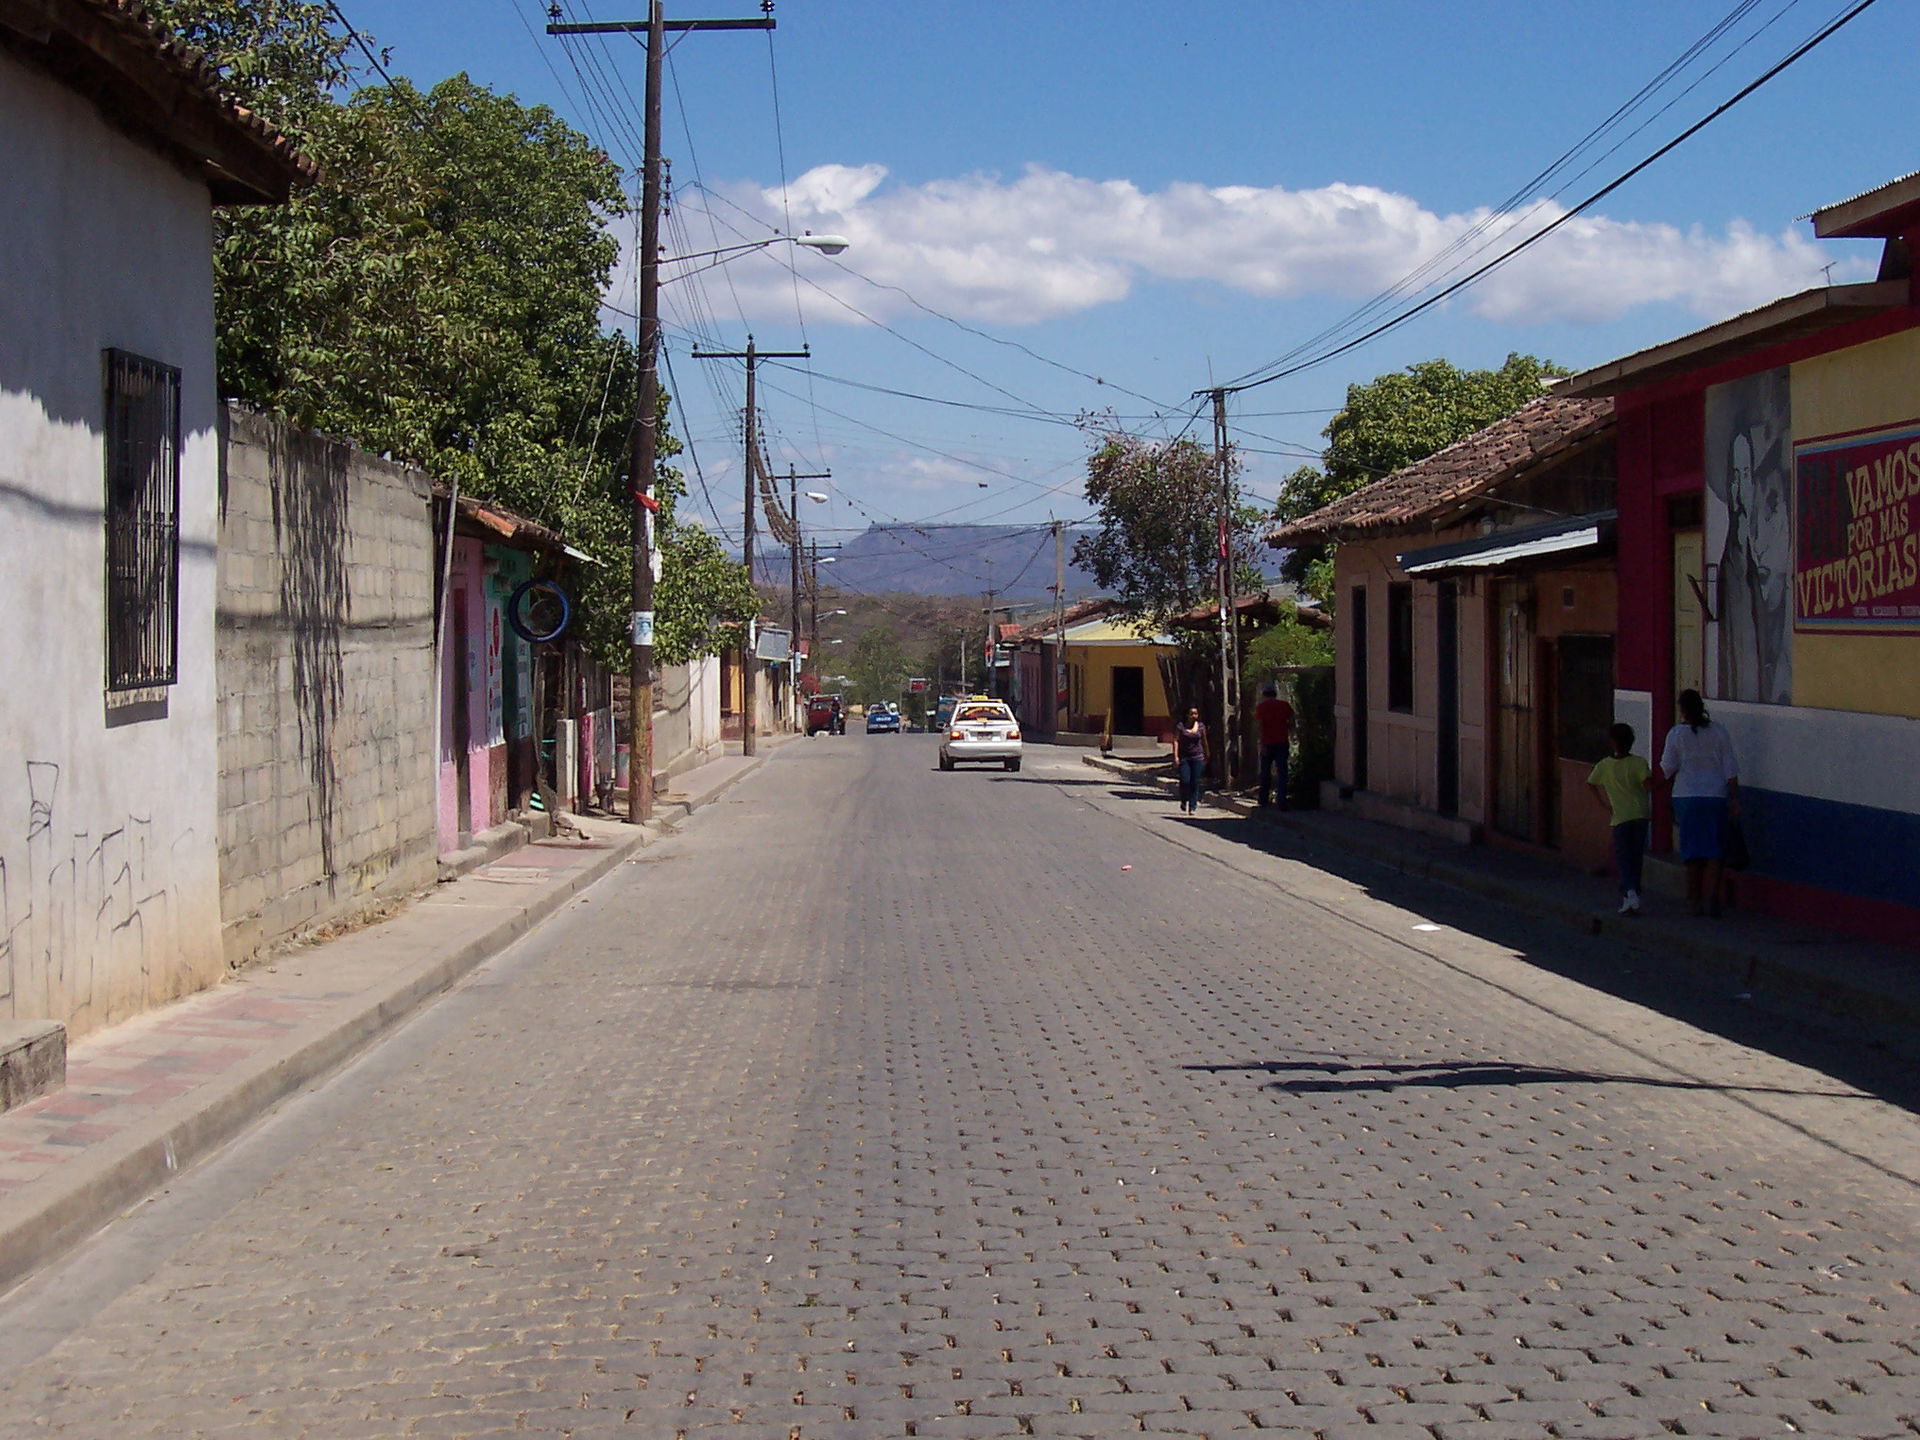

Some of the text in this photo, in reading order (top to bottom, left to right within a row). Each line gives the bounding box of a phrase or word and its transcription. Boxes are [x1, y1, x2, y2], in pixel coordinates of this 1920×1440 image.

[1846, 443, 1920, 518] VAMOS
[1848, 502, 1909, 554] POR MAS
[1797, 534, 1920, 617] VICTORIAS
